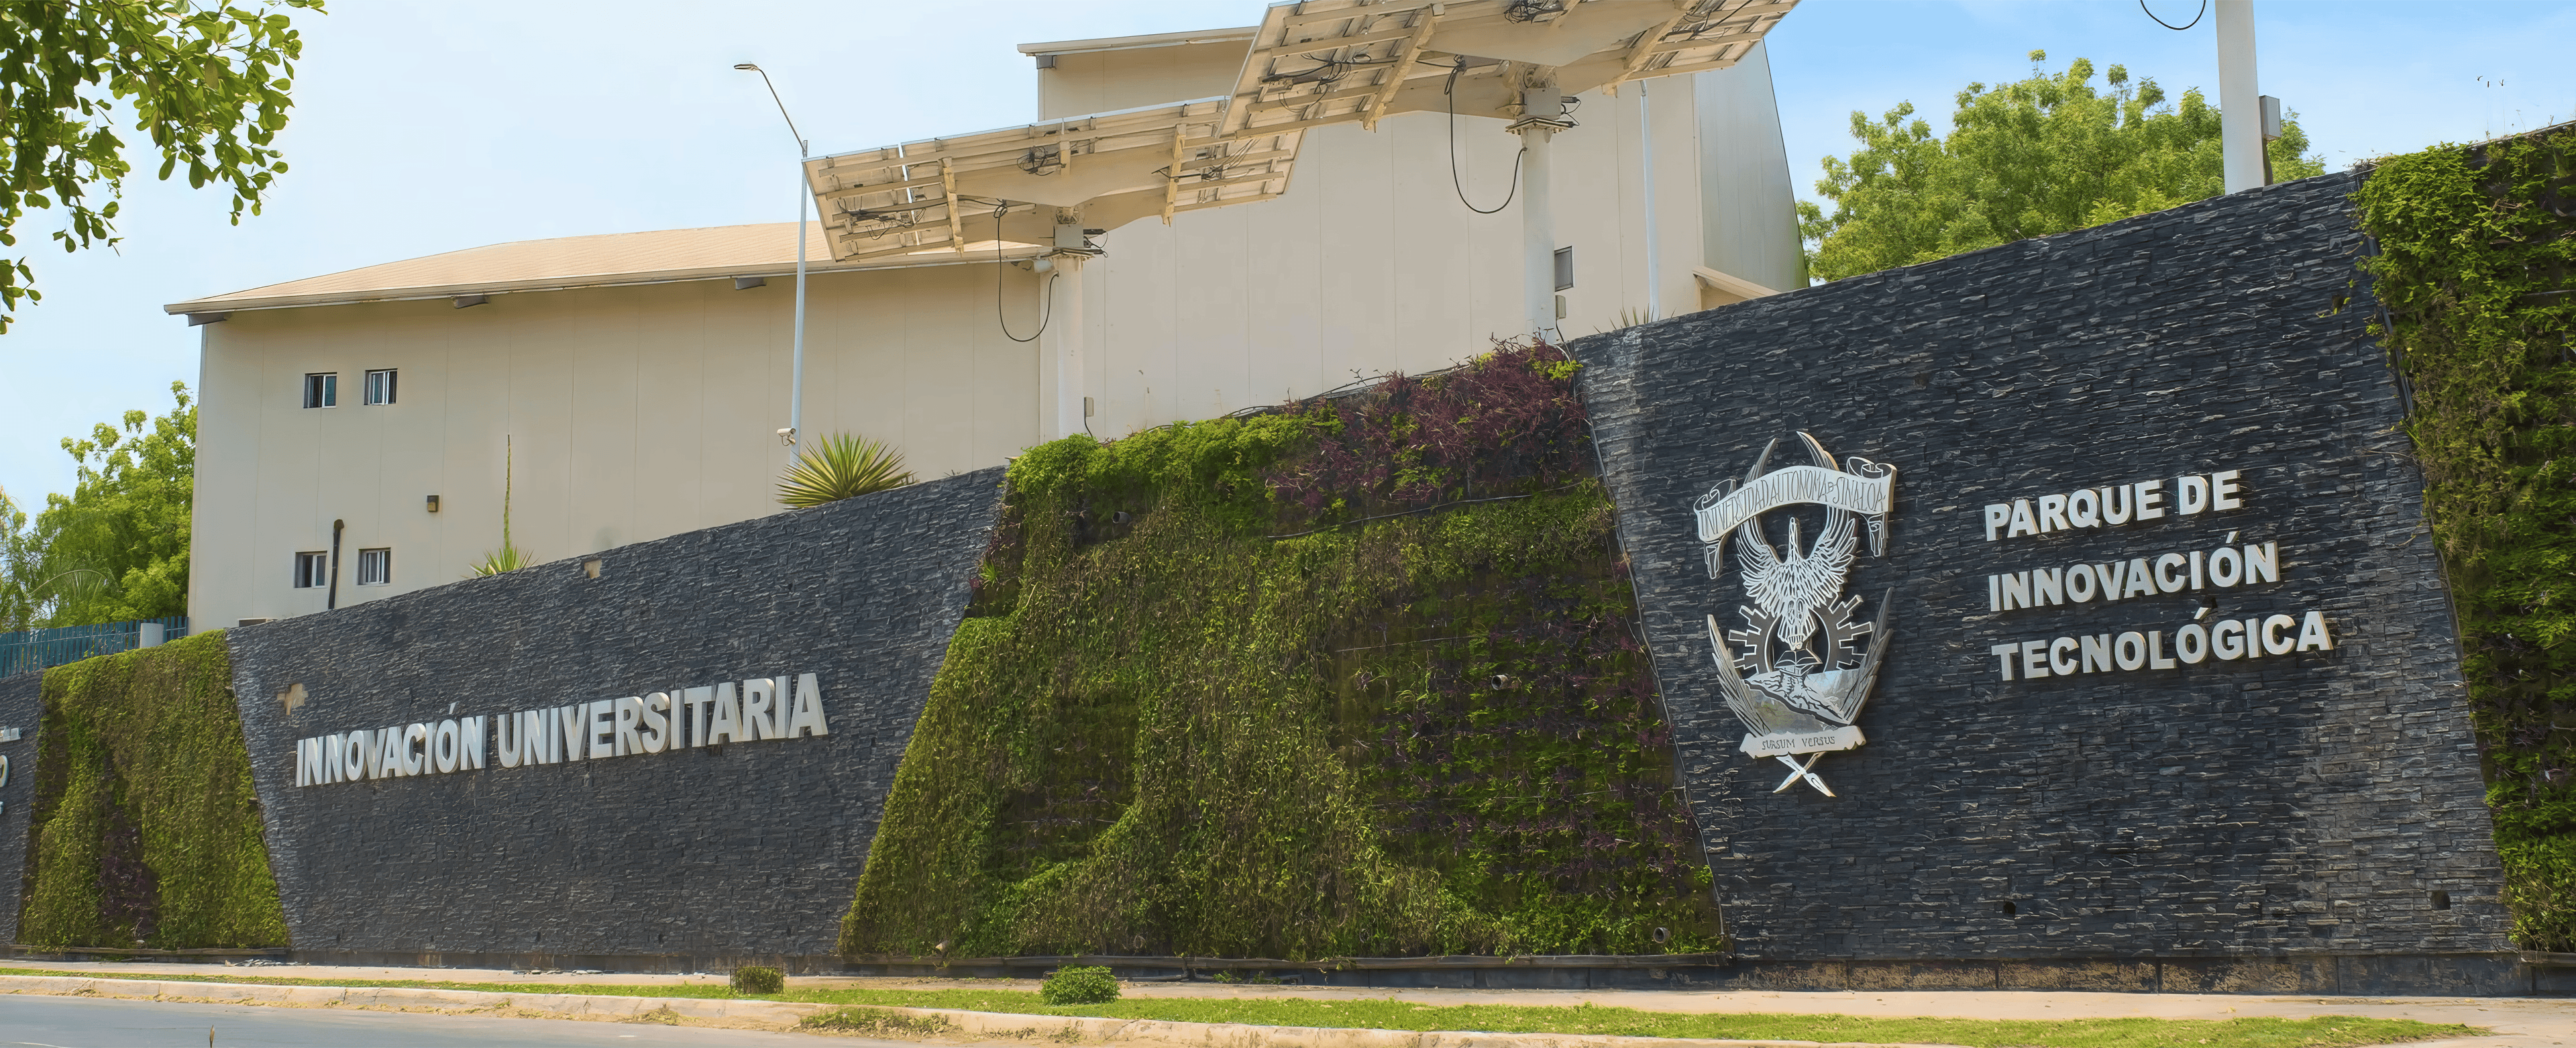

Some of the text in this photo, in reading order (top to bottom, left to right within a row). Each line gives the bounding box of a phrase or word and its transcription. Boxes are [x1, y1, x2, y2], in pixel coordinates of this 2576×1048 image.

[1984, 470, 2243, 541] PARQUE DE
[1989, 531, 2279, 612] INNOVACIÓN
[1991, 607, 2334, 681] TECNOLÓGICA
[296, 673, 829, 788] INNOVACIÓN UNIVERSITARIA
[1762, 736, 1835, 750] SURSUM VERSUS
